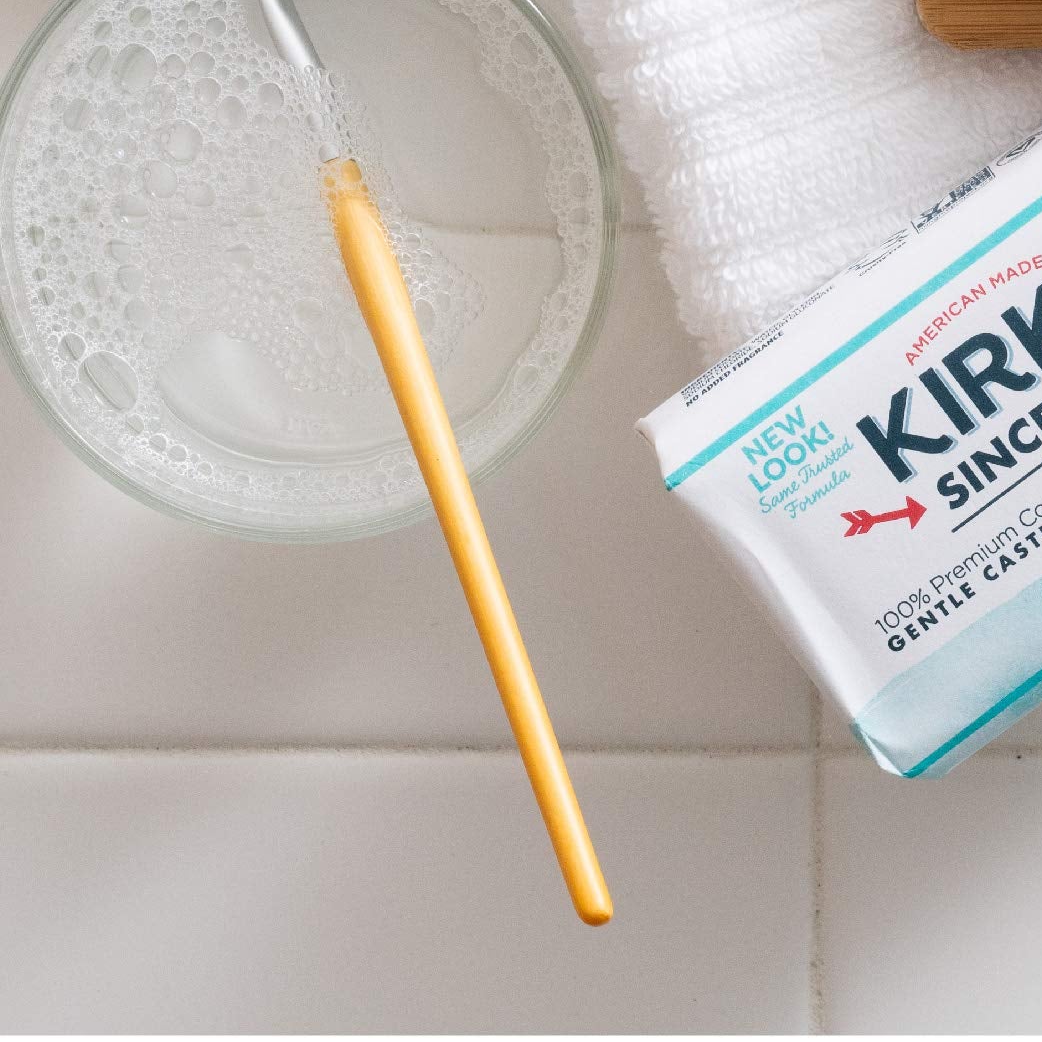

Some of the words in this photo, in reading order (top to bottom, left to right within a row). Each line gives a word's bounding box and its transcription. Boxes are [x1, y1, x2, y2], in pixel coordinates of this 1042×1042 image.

[905, 283, 987, 366] AMERICAN
[685, 395, 699, 408] NO
[701, 370, 731, 396] ADDED
[732, 330, 785, 372] FRAGRANCE
[741, 404, 807, 465] NEW
[748, 420, 835, 493] LOOK!
[759, 481, 800, 514] Same
[798, 436, 855, 484] Trusted
[784, 469, 851, 519] Formula
[874, 588, 931, 634] 100%
[929, 525, 1018, 595] Premium
[887, 581, 976, 652] GENTLE
